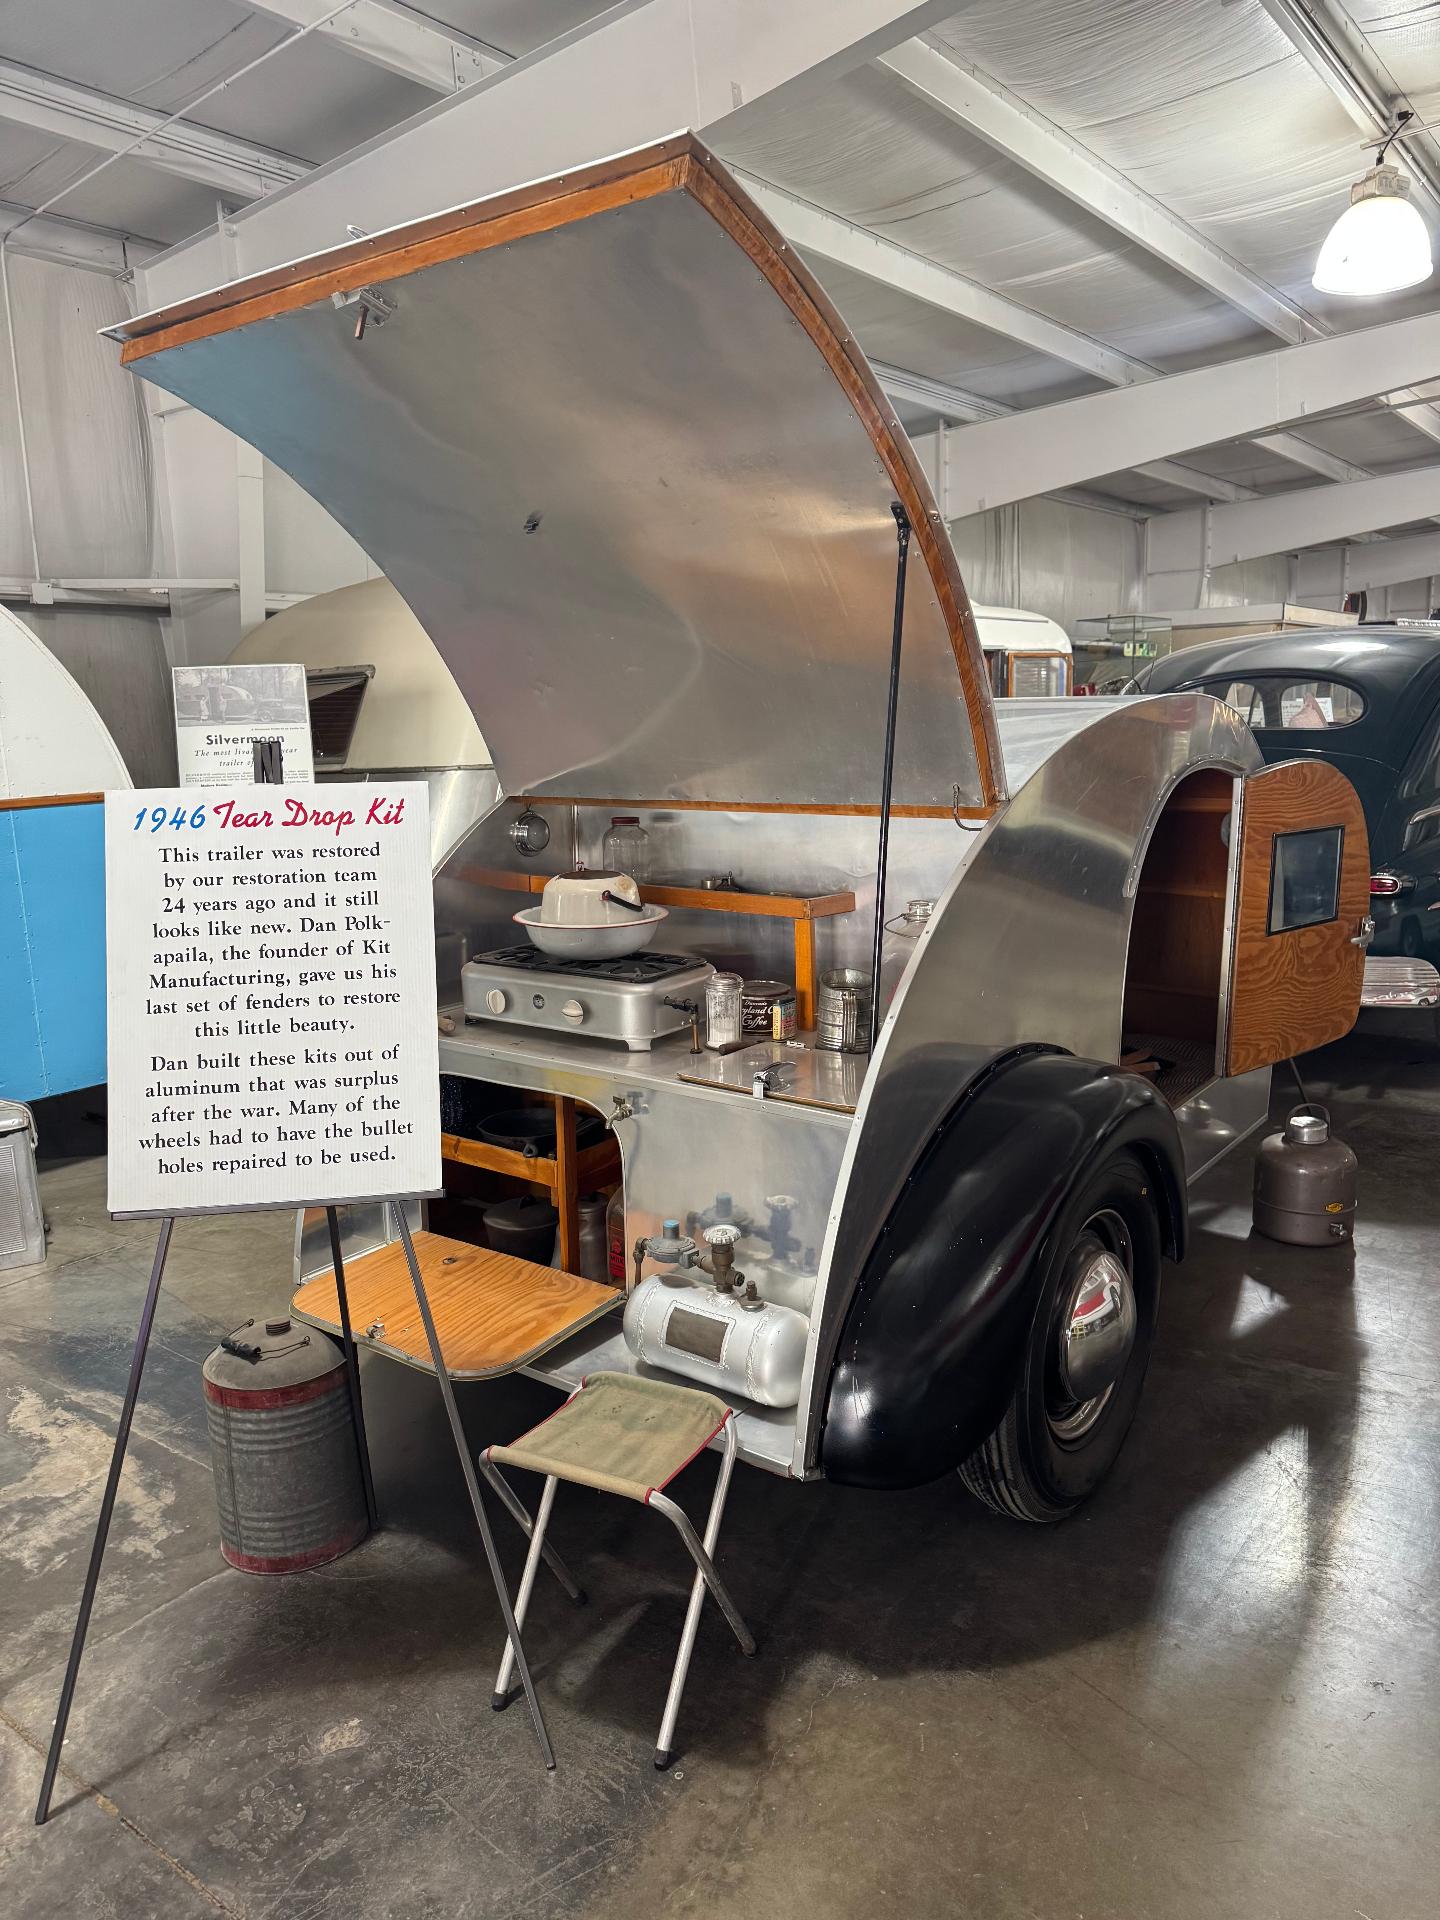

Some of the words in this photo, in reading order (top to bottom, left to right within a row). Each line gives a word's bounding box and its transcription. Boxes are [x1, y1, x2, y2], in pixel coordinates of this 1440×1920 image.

[206, 734, 285, 746] Silvermoon
[133, 804, 206, 834] 1946
[212, 799, 274, 829] Tear
[281, 798, 356, 837] Drop
[364, 797, 405, 825] Kit
[158, 847, 200, 863] This
[207, 844, 264, 862] trailer
[271, 848, 304, 859] was
[312, 841, 381, 858] restored
[163, 872, 186, 892] by
[192, 876, 224, 887] our
[232, 868, 327, 886] restoration
[334, 870, 378, 882] team
[161, 897, 186, 914] 24
[192, 900, 237, 916] years
[245, 899, 276, 914] ago
[283, 892, 316, 909] and
[324, 892, 337, 907] it
[345, 889, 379, 907] still
[152, 921, 200, 939] looks
[207, 920, 242, 936] like
[250, 923, 292, 935] new.
[298, 917, 337, 933] Dan
[344, 914, 391, 931] Polk-
[153, 946, 214, 968] apaila,
[221, 944, 251, 961] the
[258, 941, 329, 959] founder
[335, 939, 355, 956] of
[361, 939, 391, 955] Kit
[149, 969, 291, 989] Manufacturing,
[298, 970, 336, 986] gave
[343, 969, 363, 981] us
[370, 963, 397, 979] his
[145, 998, 178, 1015] last
[186, 999, 211, 1013] set
[218, 994, 238, 1012] of
[246, 992, 310, 1010] fenders
[318, 994, 336, 1007] to
[343, 992, 401, 1005] restore
[741, 1006, 767, 1017] yland
[195, 1021, 229, 1038] this
[237, 1018, 281, 1036] little
[289, 1016, 355, 1034] beauty.
[741, 1015, 768, 1029] Coffee
[150, 1055, 189, 1072] Dan
[196, 1052, 241, 1070] built
[249, 1050, 296, 1067] these
[304, 1048, 337, 1064] kits
[344, 1049, 373, 1062] out
[381, 1043, 400, 1060] of
[145, 1079, 241, 1098] aluminum
[248, 1076, 286, 1093] that
[294, 1078, 327, 1090] was
[334, 1069, 399, 1090] surplus
[151, 1105, 196, 1123] after
[203, 1103, 233, 1120] the
[239, 1106, 281, 1118] war.
[288, 1099, 338, 1117] Many
[345, 1095, 365, 1113] of
[372, 1094, 401, 1111] the
[138, 1130, 201, 1150] wheels
[208, 1127, 243, 1146] had
[251, 1130, 269, 1144] to
[276, 1125, 317, 1142] have
[324, 1122, 353, 1139] the
[360, 1118, 413, 1137] bullet
[158, 1156, 204, 1175] holes
[212, 1151, 287, 1175] repaired
[295, 1153, 313, 1167] to
[320, 1148, 342, 1165] be
[350, 1144, 396, 1163] used.
